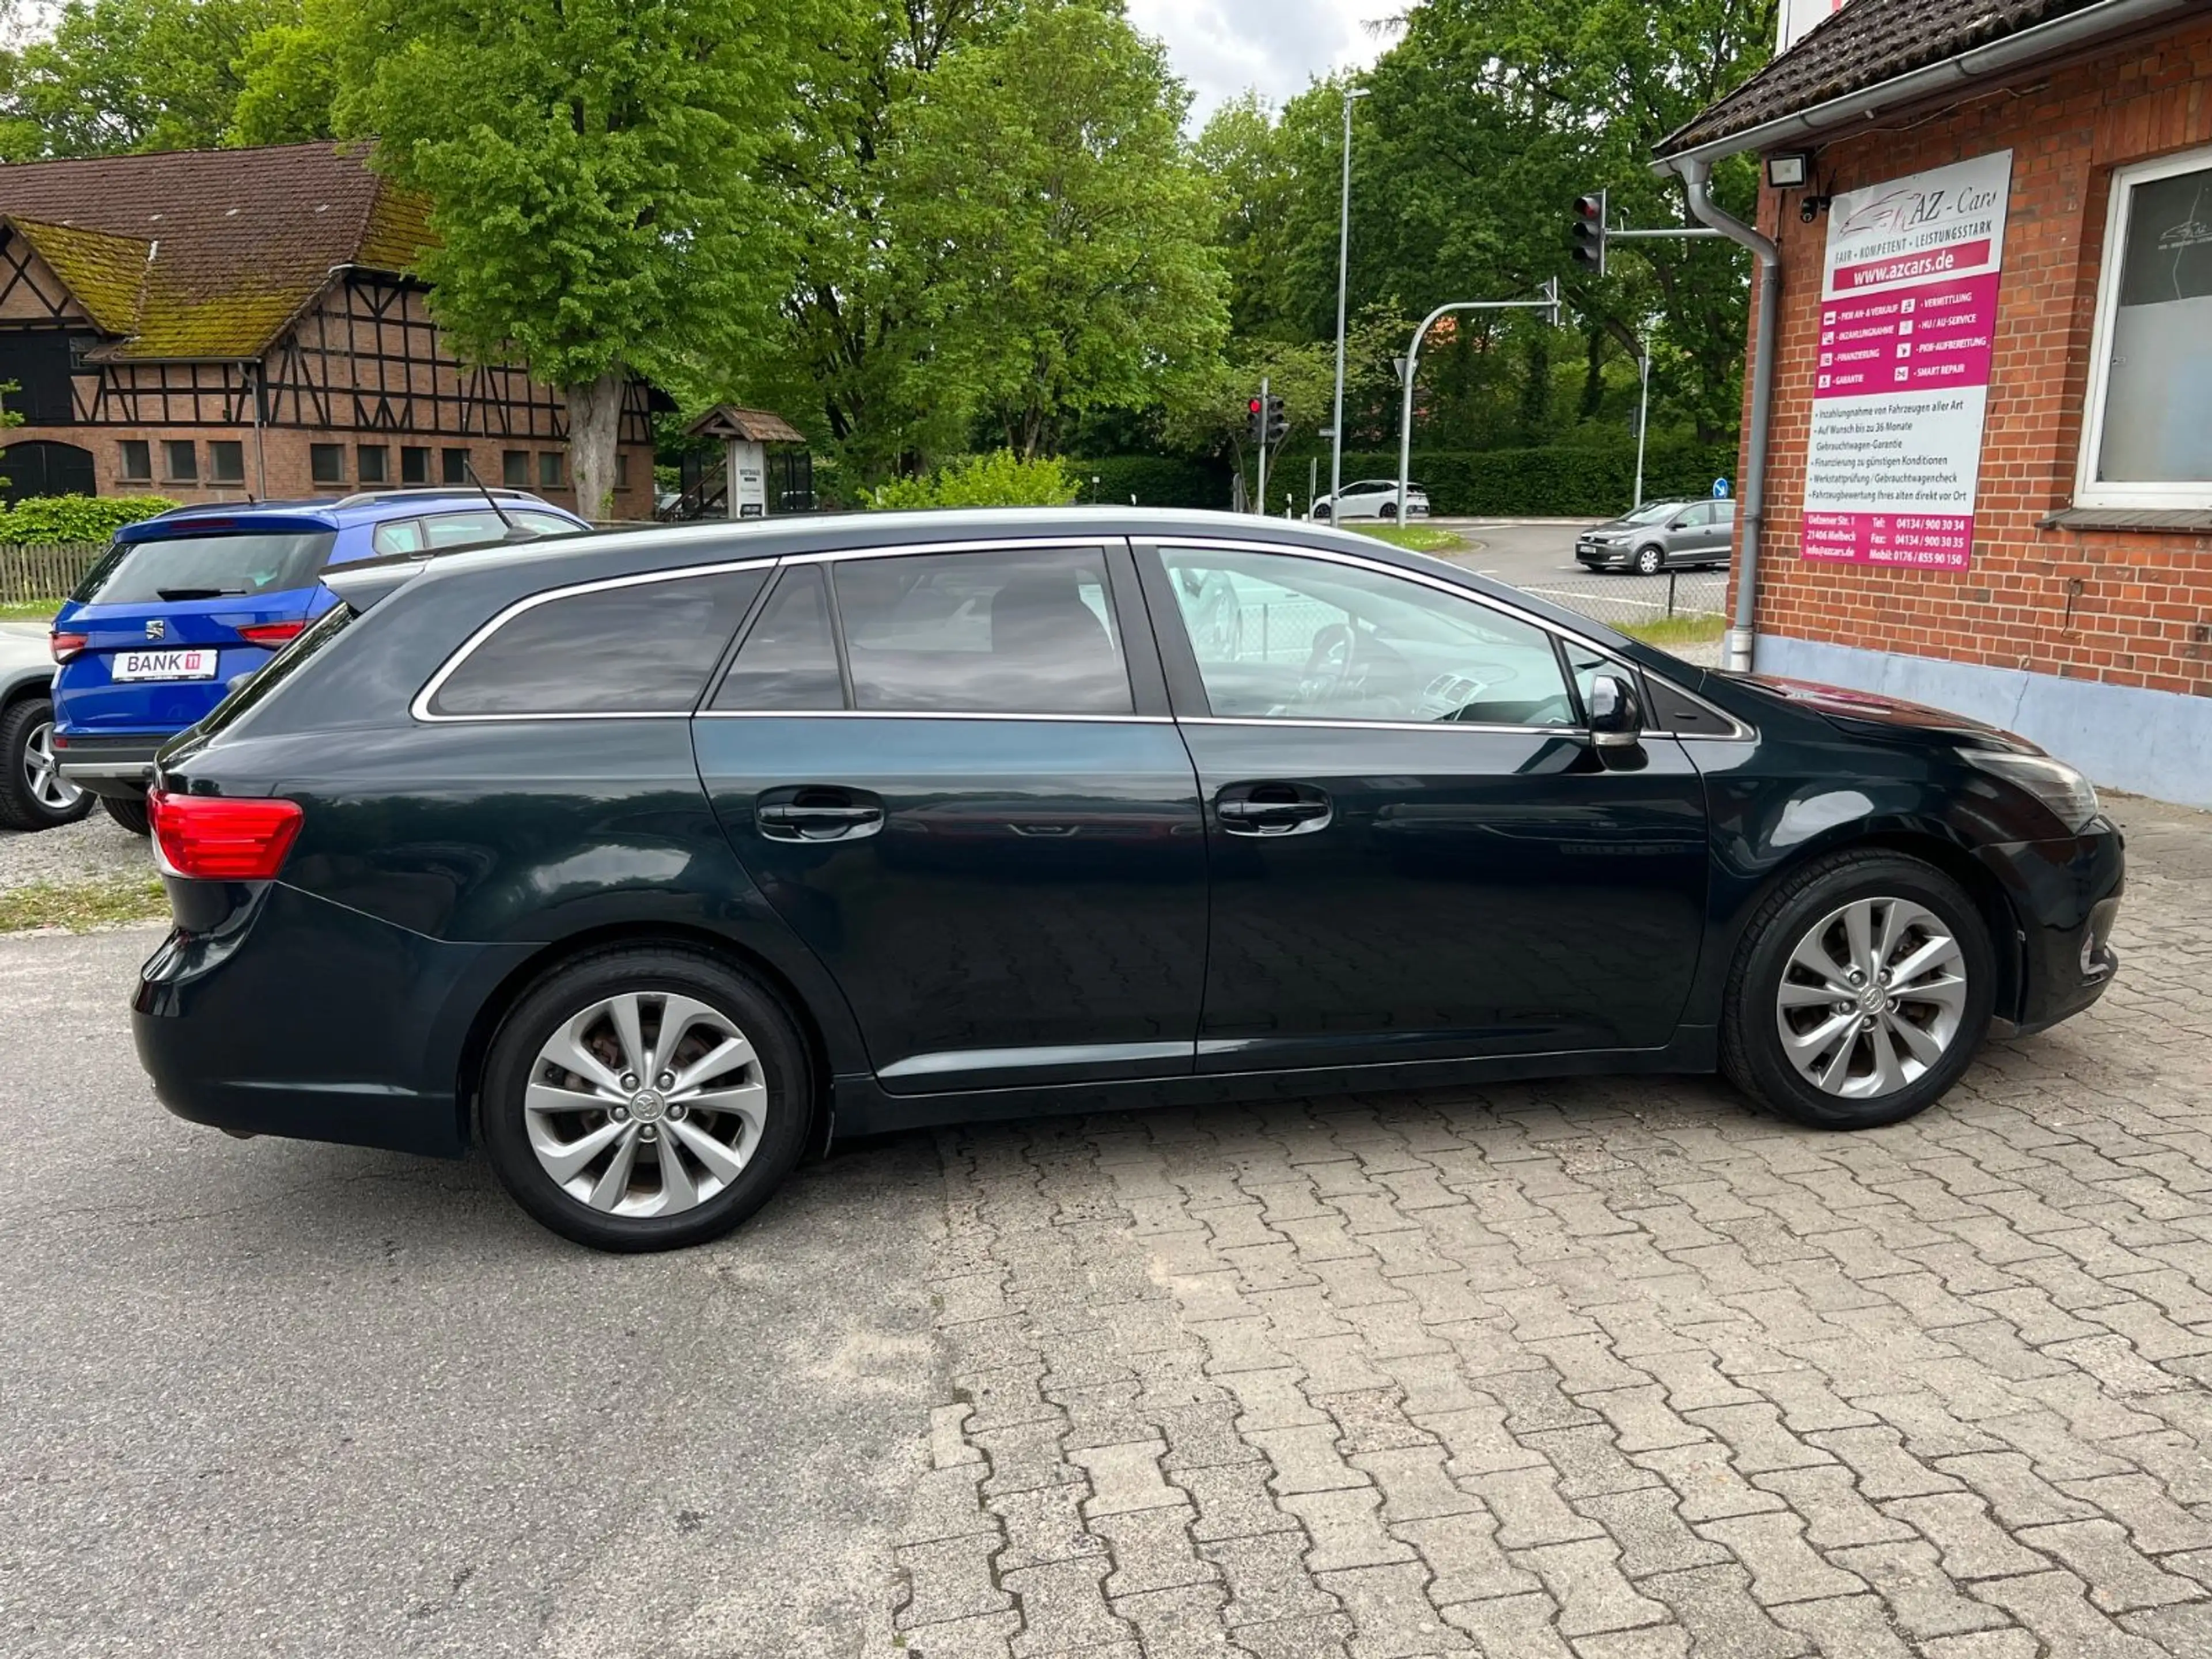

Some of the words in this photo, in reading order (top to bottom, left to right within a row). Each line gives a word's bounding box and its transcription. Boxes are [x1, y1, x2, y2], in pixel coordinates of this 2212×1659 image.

[1909, 191, 1945, 225] AZ
[1958, 187, 1998, 214] Cars
[1835, 249, 1852, 264] FAIR
[1859, 238, 1907, 259] KOMPETENT
[1915, 220, 1992, 248] LEISTUNGSSTARK
[1854, 251, 1954, 286] www.azcars.de
[1937, 314, 1976, 327] AU-SERVICE
[1917, 366, 1940, 377] SMART
[1941, 364, 1965, 375] REPAIR
[1819, 407, 1872, 419] Inzahlungnahme
[1889, 404, 1930, 415] Fahrzeugen
[1932, 401, 1949, 411] aller
[1951, 400, 1964, 410] Art
[1818, 426, 1830, 434] Auf
[1831, 425, 1854, 434] Wunsch
[1855, 423, 1865, 432] bis
[1876, 423, 1884, 431] 36
[1886, 422, 1912, 431] Monate
[1816, 439, 1902, 452] Gebrauchtwagen-Garantie
[1815, 457, 1855, 469] Finanzierung
[1866, 456, 1900, 468] günstigen
[1902, 454, 1948, 465] Konditionen
[1814, 473, 1870, 486] Werkstattprüfung
[1874, 471, 1957, 486] Gebrauchtwagencheck
[1812, 490, 1876, 502] Fahrzeugbewertung
[1877, 490, 1894, 500] Ihres
[1896, 491, 1914, 501] alten
[1915, 490, 1938, 501] direkt
[1939, 493, 1951, 501] vor
[1953, 491, 1967, 501] Ort
[1896, 518, 1920, 529] 04134
[1925, 519, 1941, 531] 900
[1941, 519, 1953, 531] 30
[1953, 520, 1964, 531] 34
[1895, 534, 1919, 546] 04134
[1925, 535, 1940, 547] 900
[1941, 536, 1952, 547] 30
[1952, 536, 1964, 548] 35
[1894, 550, 1913, 562] 0176
[127, 654, 183, 672] BANK
